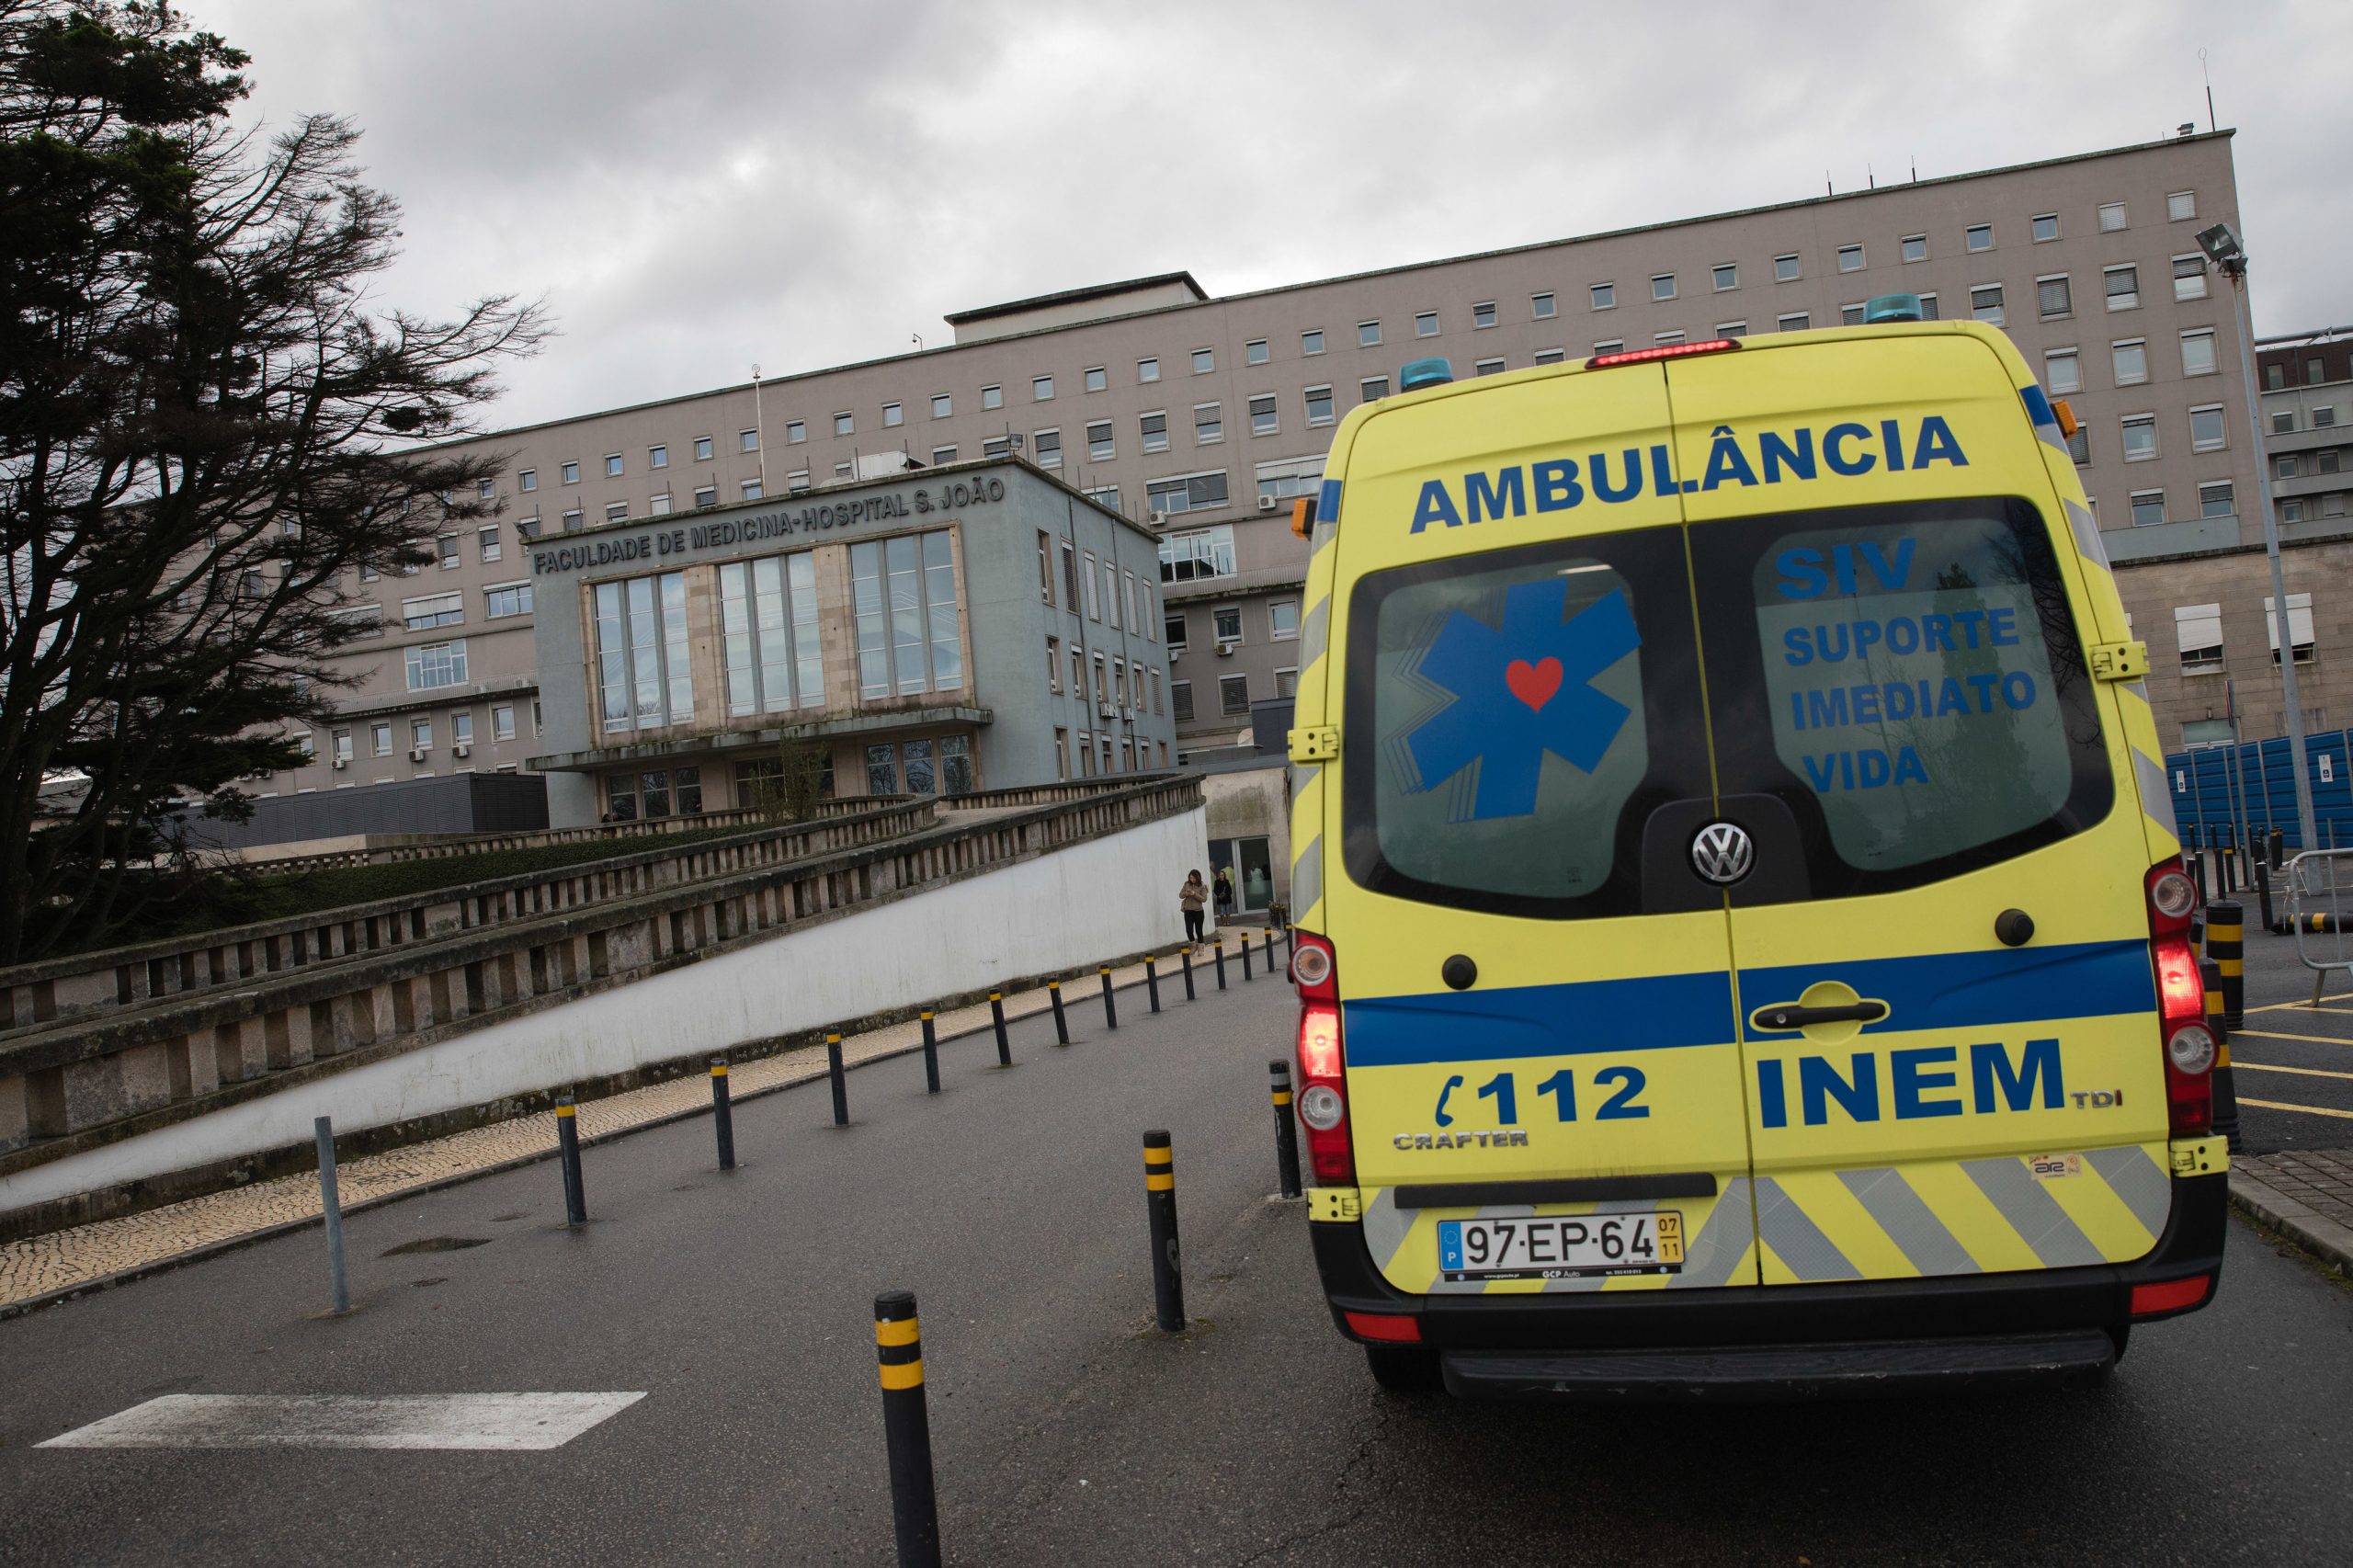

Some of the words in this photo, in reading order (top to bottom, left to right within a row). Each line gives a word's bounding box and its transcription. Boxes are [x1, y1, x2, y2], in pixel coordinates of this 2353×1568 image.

[1409, 415, 1970, 535] AMBULÂNCIA
[534, 535, 651, 574] FACULDADE
[656, 529, 685, 555] DE
[914, 489, 934, 513] S.
[939, 476, 1005, 509] JOÃO
[1775, 538, 1916, 600] SIV
[1783, 608, 2019, 666] SUPORTE
[1790, 671, 2036, 731] IMEDIATO
[1802, 745, 1928, 793] VIDA
[1477, 1066, 1650, 1125] 112
[1756, 1039, 2064, 1129] INEM
[2069, 1089, 2123, 1110] TDI
[1392, 1129, 1529, 1150] CRAFTER
[1658, 1218, 1677, 1232] 07
[1662, 1243, 1678, 1256] 11
[1447, 1251, 1456, 1262] P
[1542, 1270, 1562, 1278] GCP
[1563, 1269, 1580, 1278] Auto
